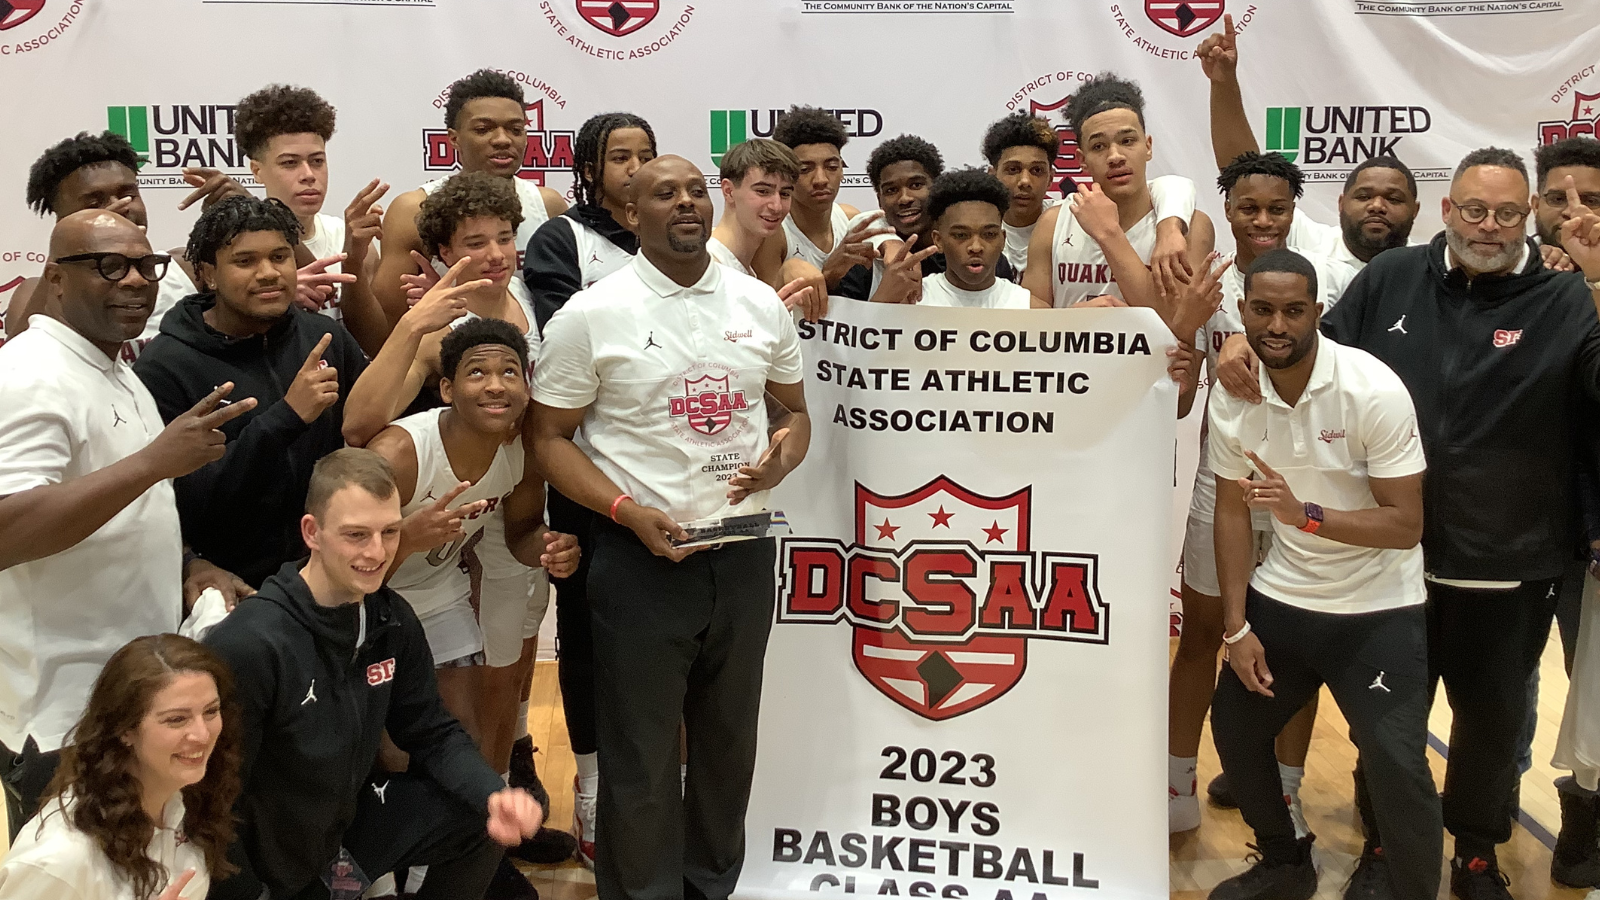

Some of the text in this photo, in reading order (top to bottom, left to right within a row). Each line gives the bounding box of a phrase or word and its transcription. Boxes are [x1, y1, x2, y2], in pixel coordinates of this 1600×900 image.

[804, 2, 1012, 10] THE COMMUNITY BANK OF THE NATION'S CAPITAL
[1357, 3, 1376, 11] THE
[1377, 4, 1426, 13] COMMUNITY
[1428, 5, 1453, 13] BANK
[1468, 4, 1486, 12] THE
[1487, 3, 1527, 11] NATION'S
[1528, 1, 1562, 10] CAPITAL
[539, 1, 695, 60] STATE ATHLETIC ASSOCIATION
[1110, 4, 1135, 38] STATE
[1133, 37, 1188, 60] ATHLETIC
[507, 70, 567, 110] COLUMBIA
[1006, 74, 1052, 111] DISTRICT
[1056, 71, 1074, 82] OF
[1551, 65, 1595, 103] DISTRICT
[152, 104, 237, 135] UNIT
[1305, 106, 1431, 134] UNITED
[1304, 136, 1403, 164] BANK
[1314, 172, 1338, 180] BANK
[1413, 171, 1449, 179] CAPITAL
[2, 252, 21, 262] OF
[1058, 262, 1117, 285] QUAK
[723, 329, 753, 343] Sidwell
[798, 317, 1152, 356] STRICT OF COLUMBIA
[816, 359, 1090, 394] STATE ATHLETIC
[669, 390, 749, 418] DCSAA
[833, 403, 1055, 434] ASSOCIATION
[716, 416, 751, 448] ASSOCIATIO
[710, 453, 741, 462] STATE
[781, 542, 1104, 641] DCSAA
[879, 745, 997, 788] 2023
[871, 793, 1000, 837] BOYS
[772, 827, 1100, 889] BASKETBALL
